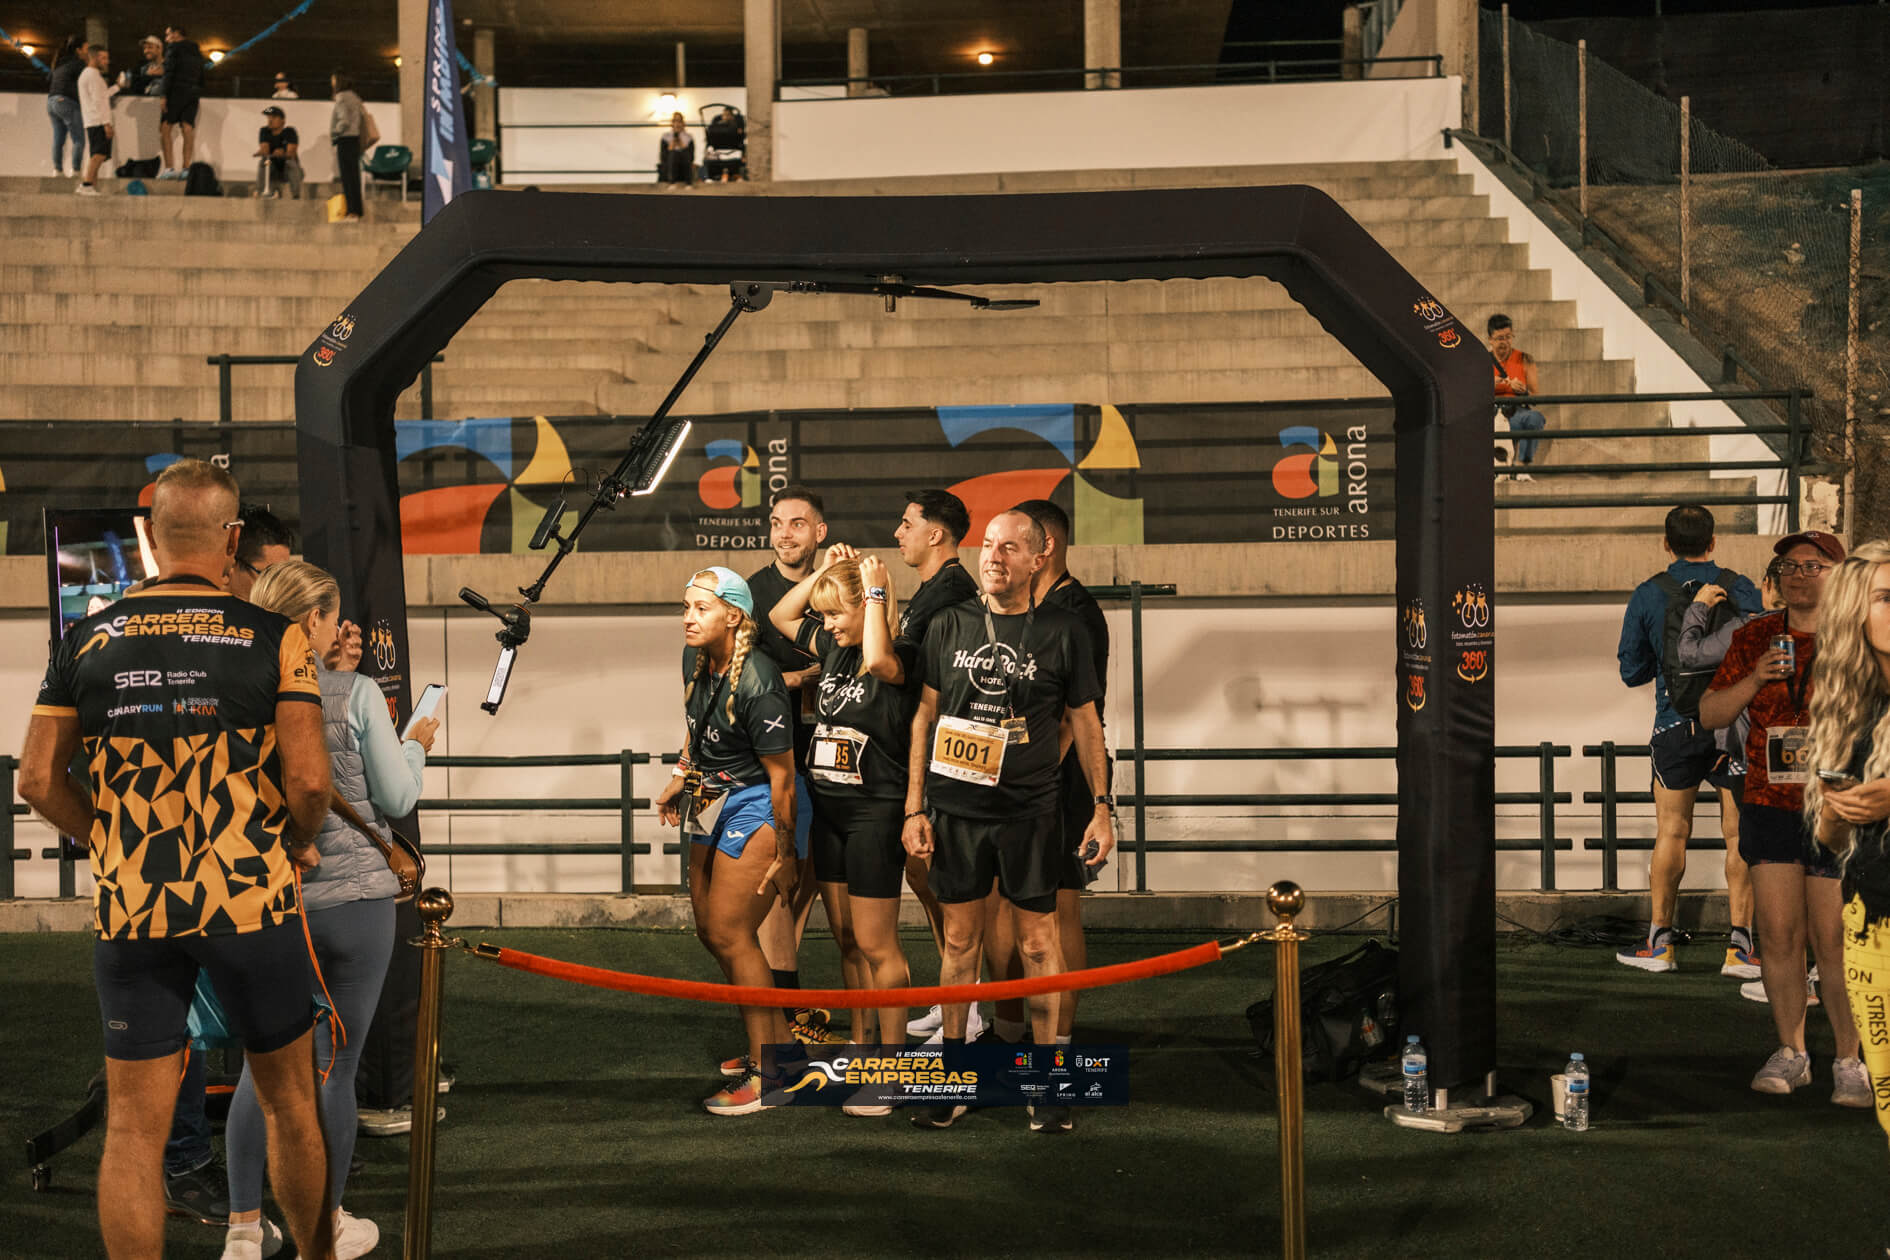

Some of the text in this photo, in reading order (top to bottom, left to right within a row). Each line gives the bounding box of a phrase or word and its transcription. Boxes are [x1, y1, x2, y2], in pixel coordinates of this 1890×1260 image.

[1273, 507, 1340, 517] TENERIFE SUR
[699, 518, 761, 527] TENERIFE SUR
[1272, 524, 1369, 539] DEPORTES
[696, 534, 773, 548] DEPORT
[113, 613, 224, 627] CARRERA
[124, 624, 255, 640] EMPRESAS
[181, 635, 253, 647] TENERIFE
[189, 670, 207, 678] Club
[294, 665, 308, 677] el
[980, 675, 1004, 686] HOTE
[969, 702, 1006, 714] TENERIFE
[944, 737, 990, 764] 1001
[1865, 995, 1889, 1046] STRESS
